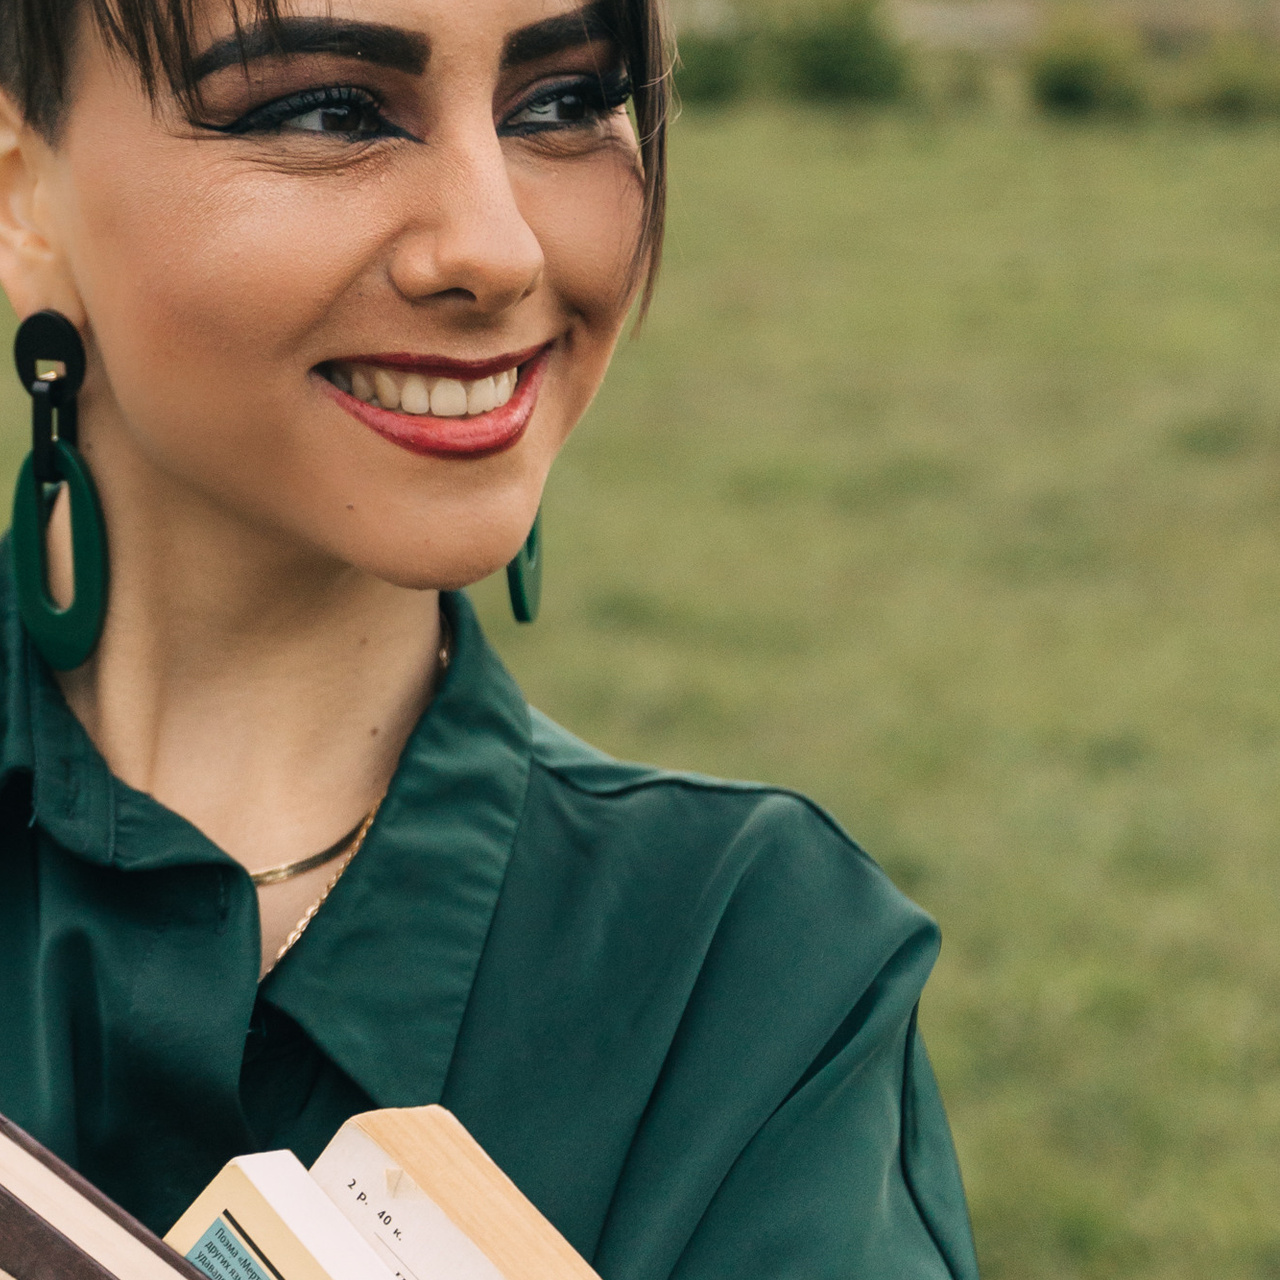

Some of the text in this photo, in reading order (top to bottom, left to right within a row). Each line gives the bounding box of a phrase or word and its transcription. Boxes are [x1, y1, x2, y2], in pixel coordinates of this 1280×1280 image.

[348, 1179, 356, 1189] 2
[378, 1211, 392, 1225] 40
[204, 1241, 231, 1269] других
[215, 1228, 238, 1258] Поэма
